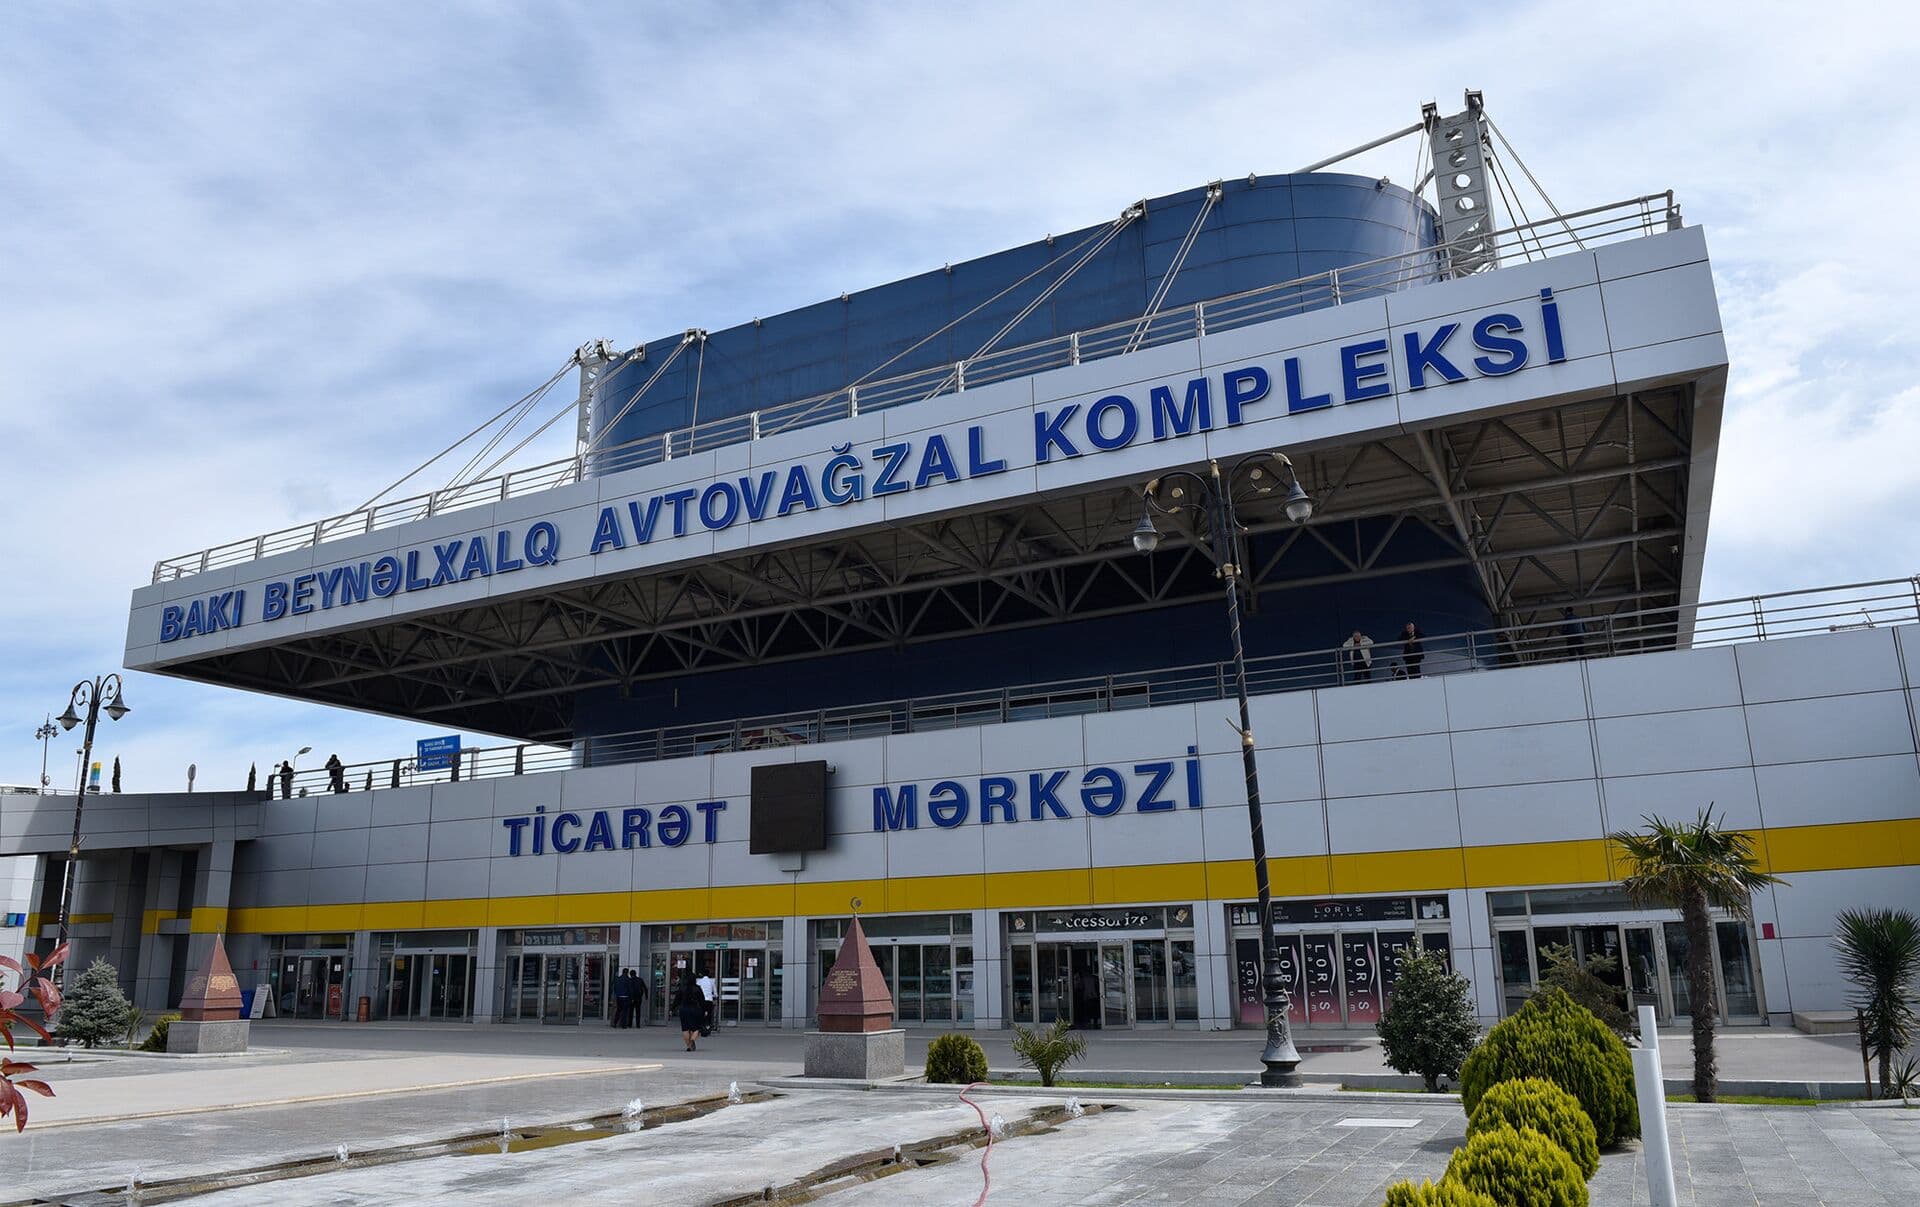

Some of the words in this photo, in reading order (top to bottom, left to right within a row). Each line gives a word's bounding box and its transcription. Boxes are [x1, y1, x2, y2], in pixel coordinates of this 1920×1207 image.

[159, 589, 244, 643] BAKI
[262, 519, 560, 622] BEYNƏLXALQ
[589, 424, 1008, 555] AVTOVAĞZAL
[1033, 286, 1568, 465] KOMPLEKSİ
[503, 800, 727, 858] TİCARƏT
[872, 744, 1203, 833] MƏRKƏZİ
[1051, 912, 1149, 929] ccessorize
[1314, 905, 1363, 914] LORIS
[1245, 961, 1256, 1003] LORIS
[1314, 944, 1331, 1010] LORIS
[1353, 943, 1370, 1010] LORIS
